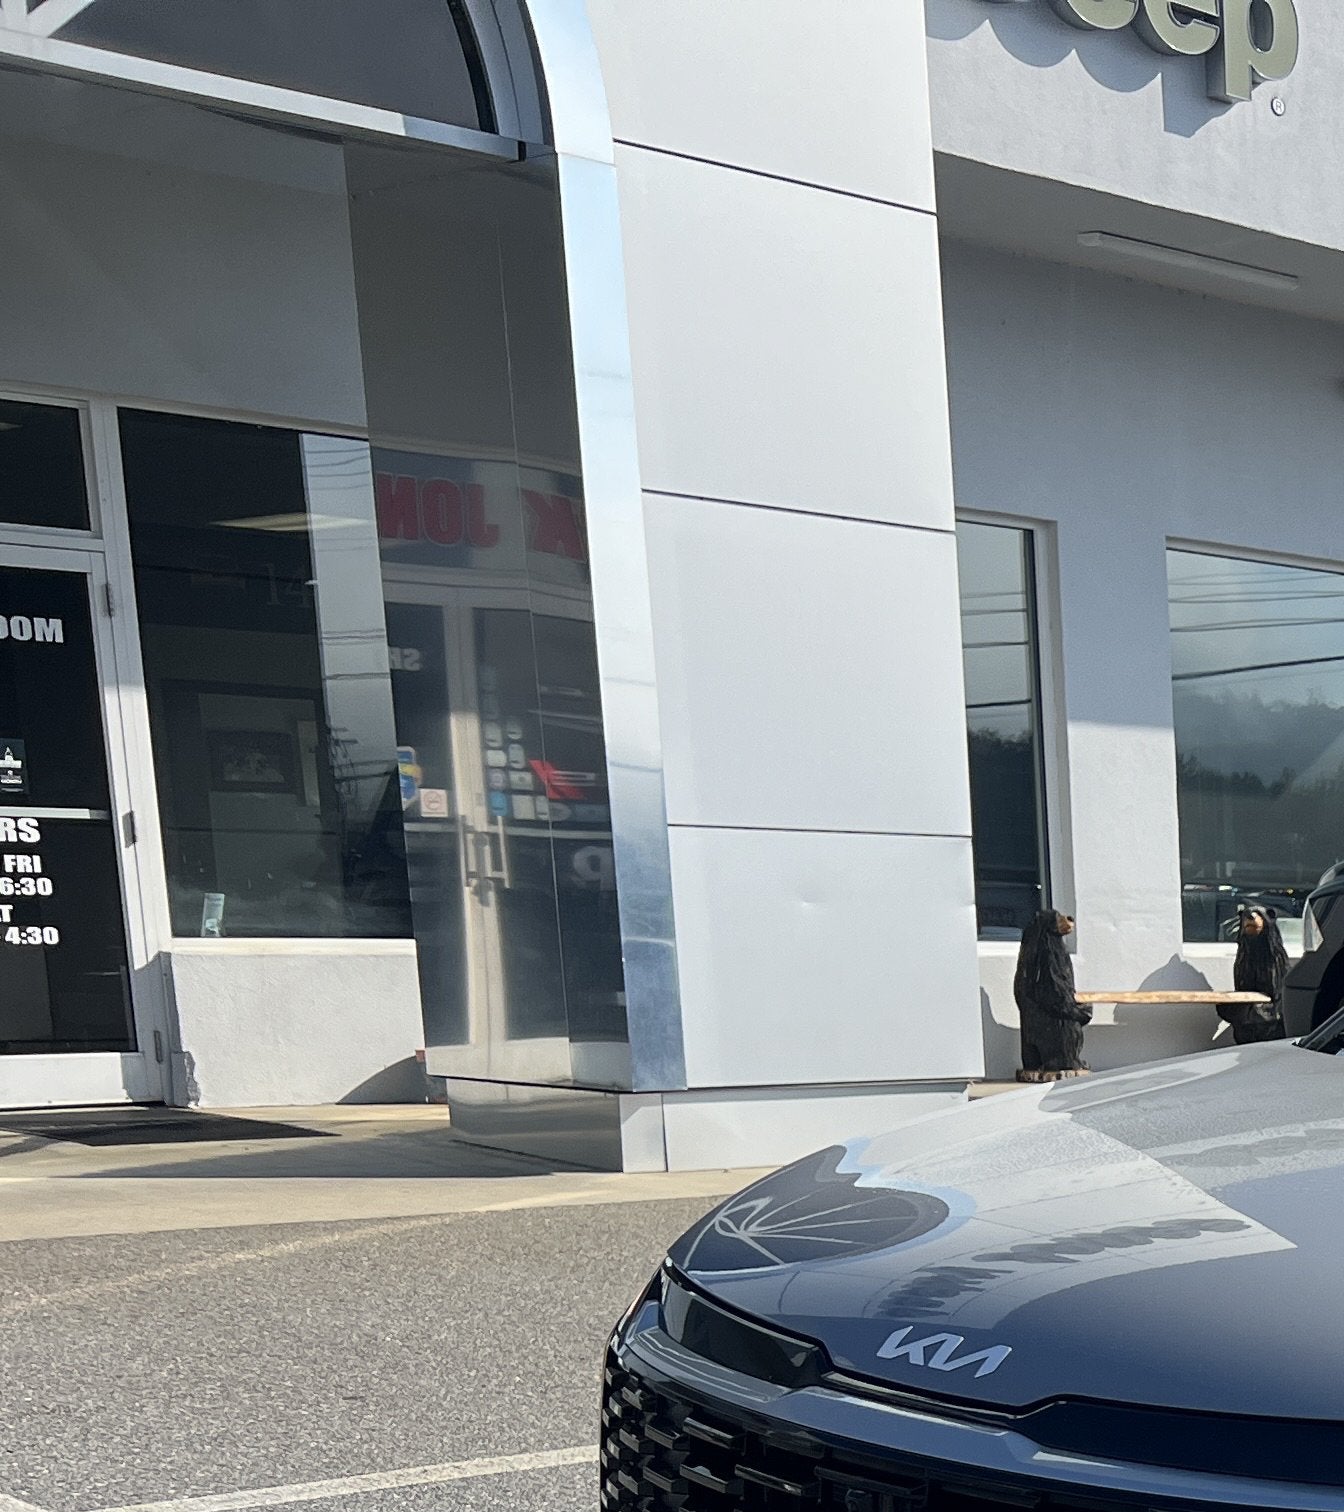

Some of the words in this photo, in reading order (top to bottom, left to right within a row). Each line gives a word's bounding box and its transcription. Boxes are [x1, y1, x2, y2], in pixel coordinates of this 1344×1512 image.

[4, 854, 42, 873] FRI
[0, 877, 53, 896] 6:30
[5, 926, 60, 945] 4:30
